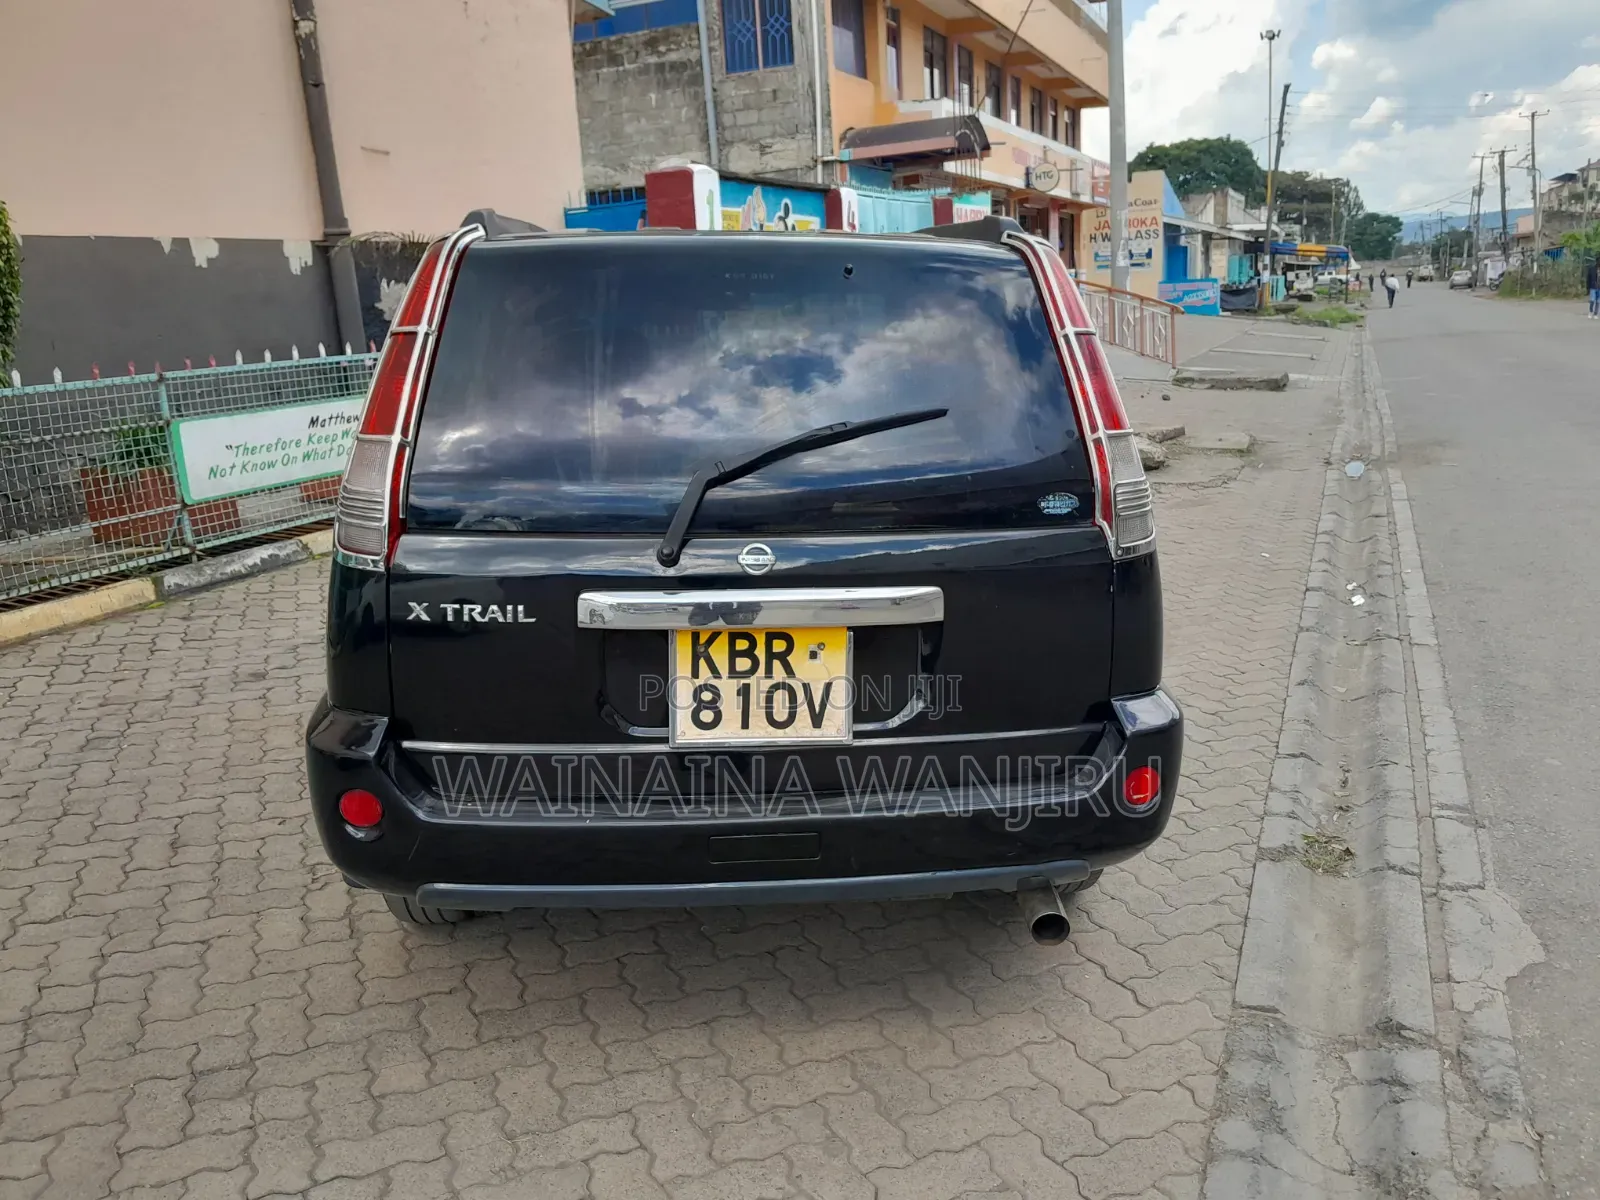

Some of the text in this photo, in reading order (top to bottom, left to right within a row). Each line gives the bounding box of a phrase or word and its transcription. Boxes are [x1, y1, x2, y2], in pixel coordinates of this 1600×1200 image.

[1127, 229, 1159, 241] LASS
[306, 430, 338, 447] Keep
[208, 462, 236, 480] Not
[239, 458, 278, 475] Know
[281, 453, 298, 467] On
[302, 447, 334, 463] What
[406, 601, 537, 623] X TRAIL
[690, 631, 796, 680] KBR
[690, 681, 834, 731] 810V
